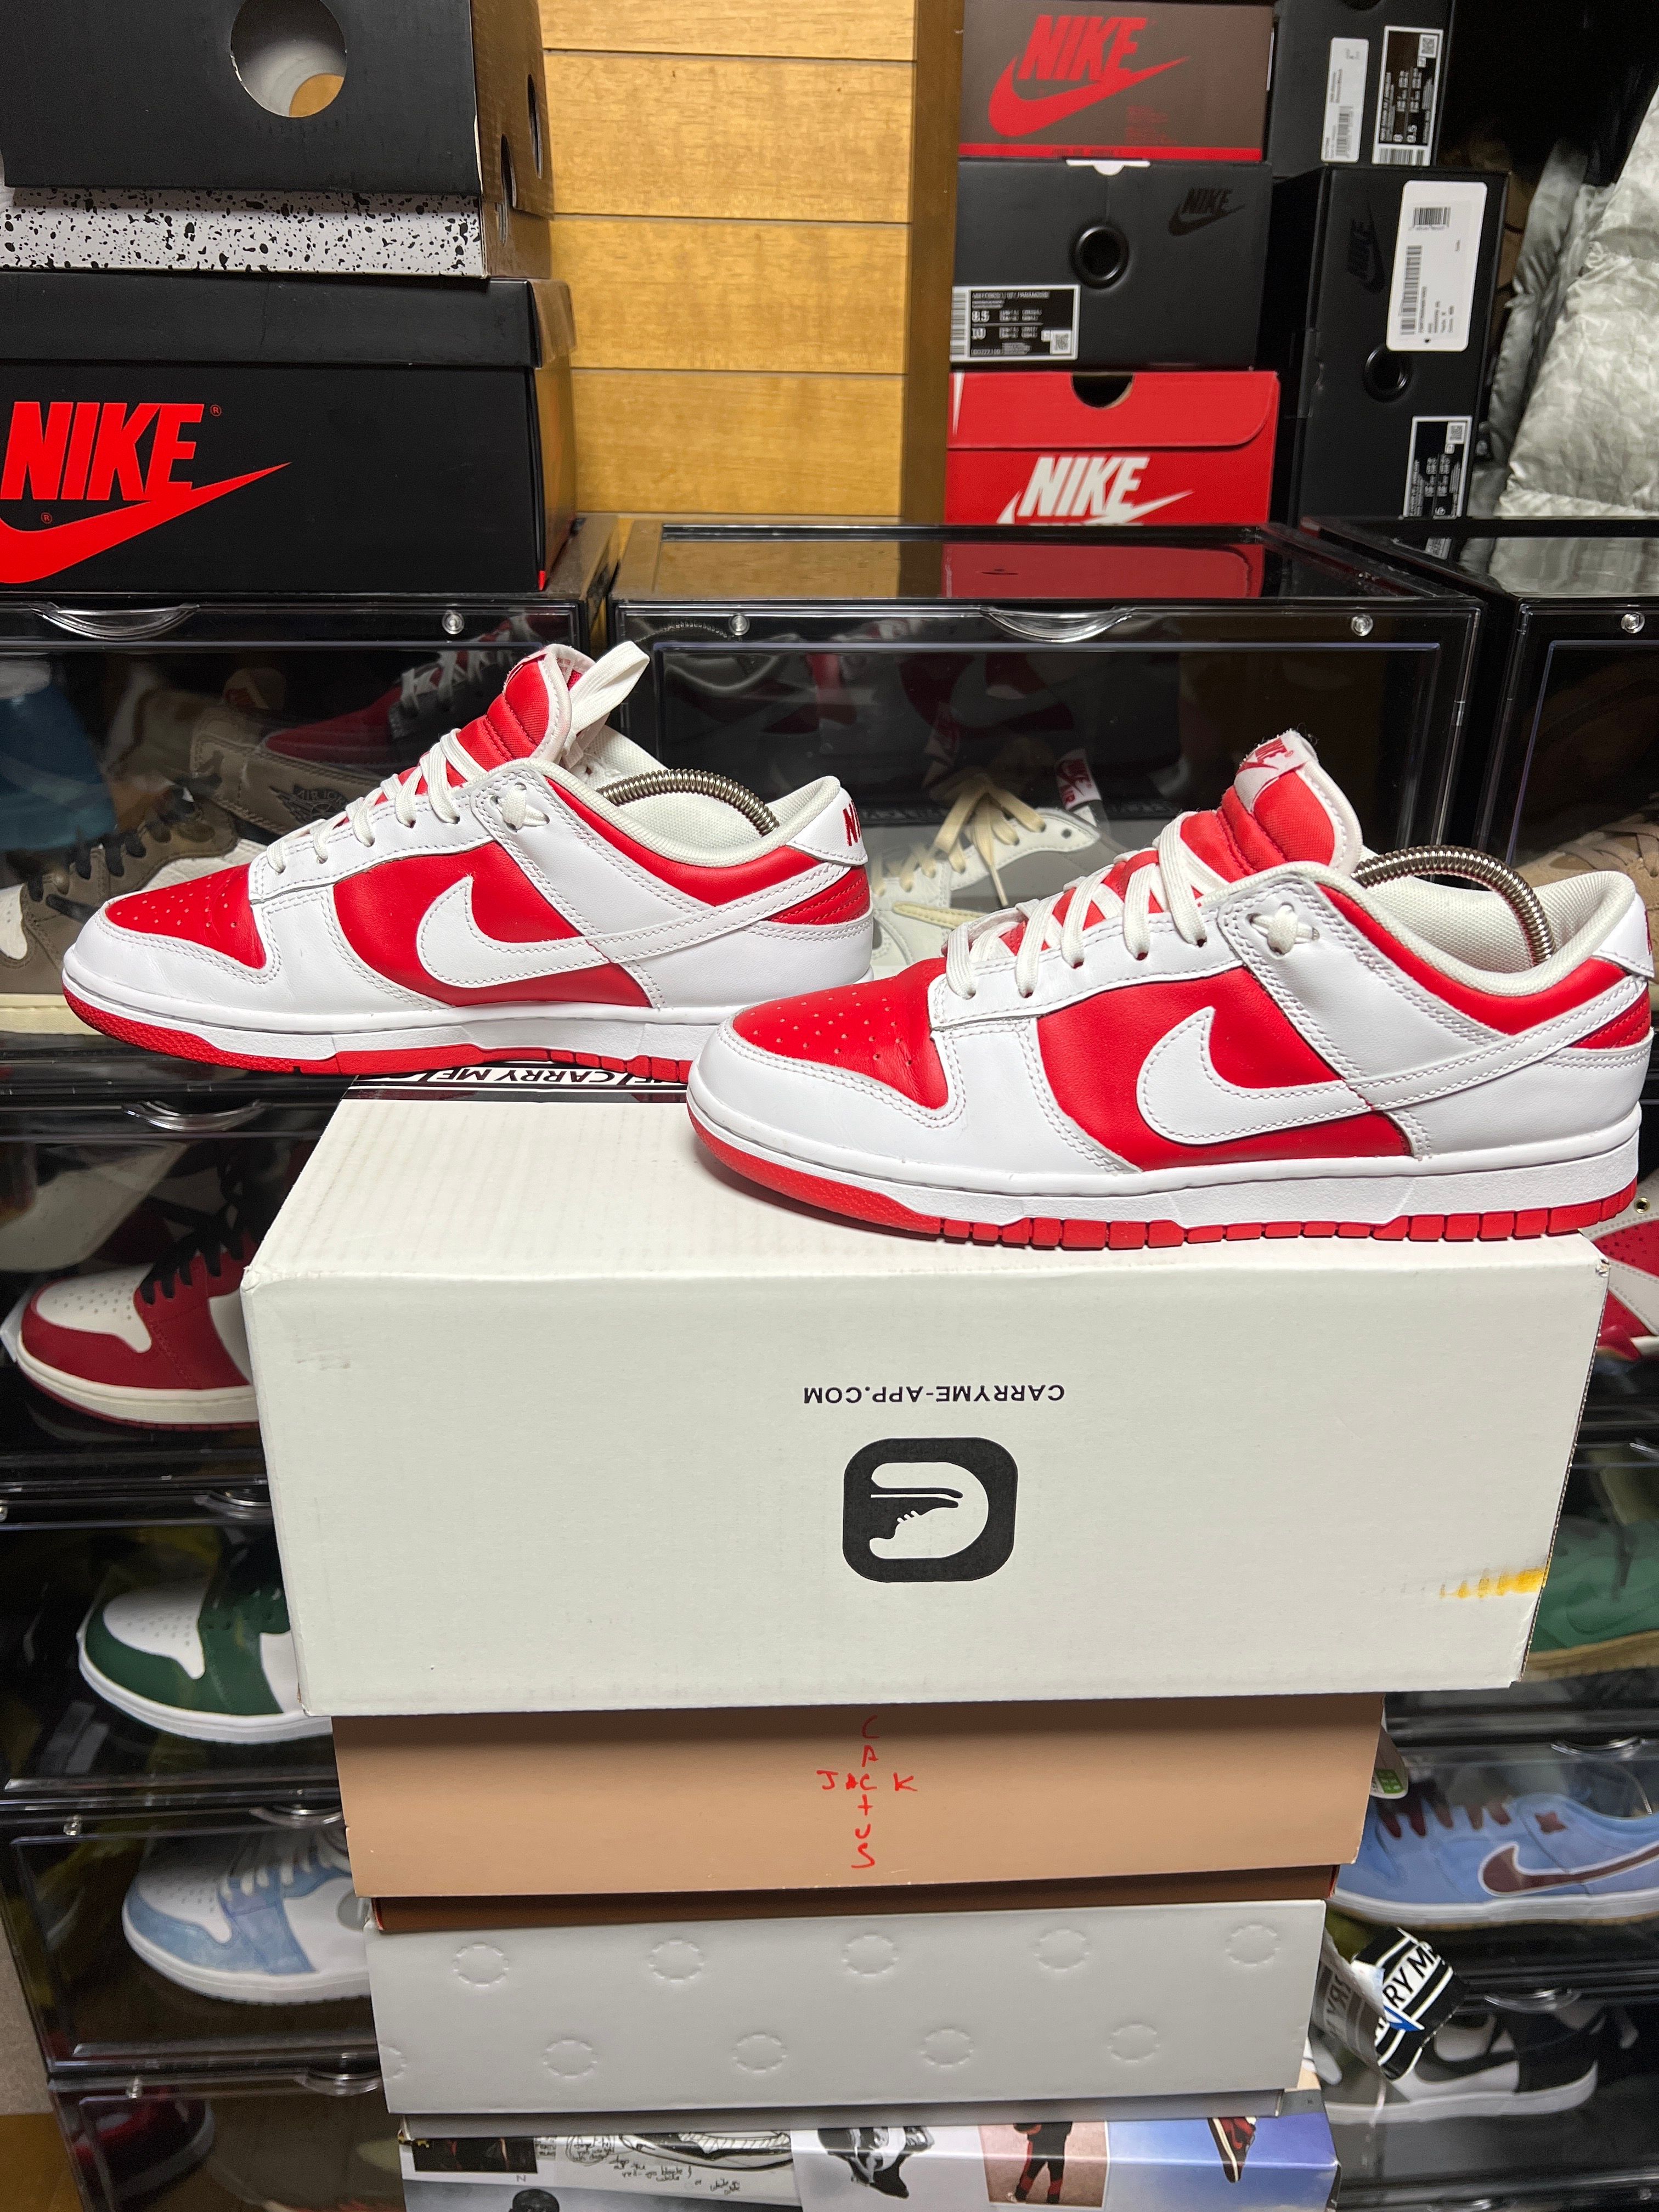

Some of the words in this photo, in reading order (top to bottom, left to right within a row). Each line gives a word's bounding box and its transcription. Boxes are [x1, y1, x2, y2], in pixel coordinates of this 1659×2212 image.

[1019, 15, 1147, 81] NIKE
[1182, 188, 1233, 215] NIKE
[0, 401, 205, 501] NIKE
[1018, 455, 1150, 517] NIKE
[494, 1069, 615, 1082] CARRY
[804, 1384, 1065, 1404] CARRYME-APP.COM
[816, 1769, 918, 1792] JACK
